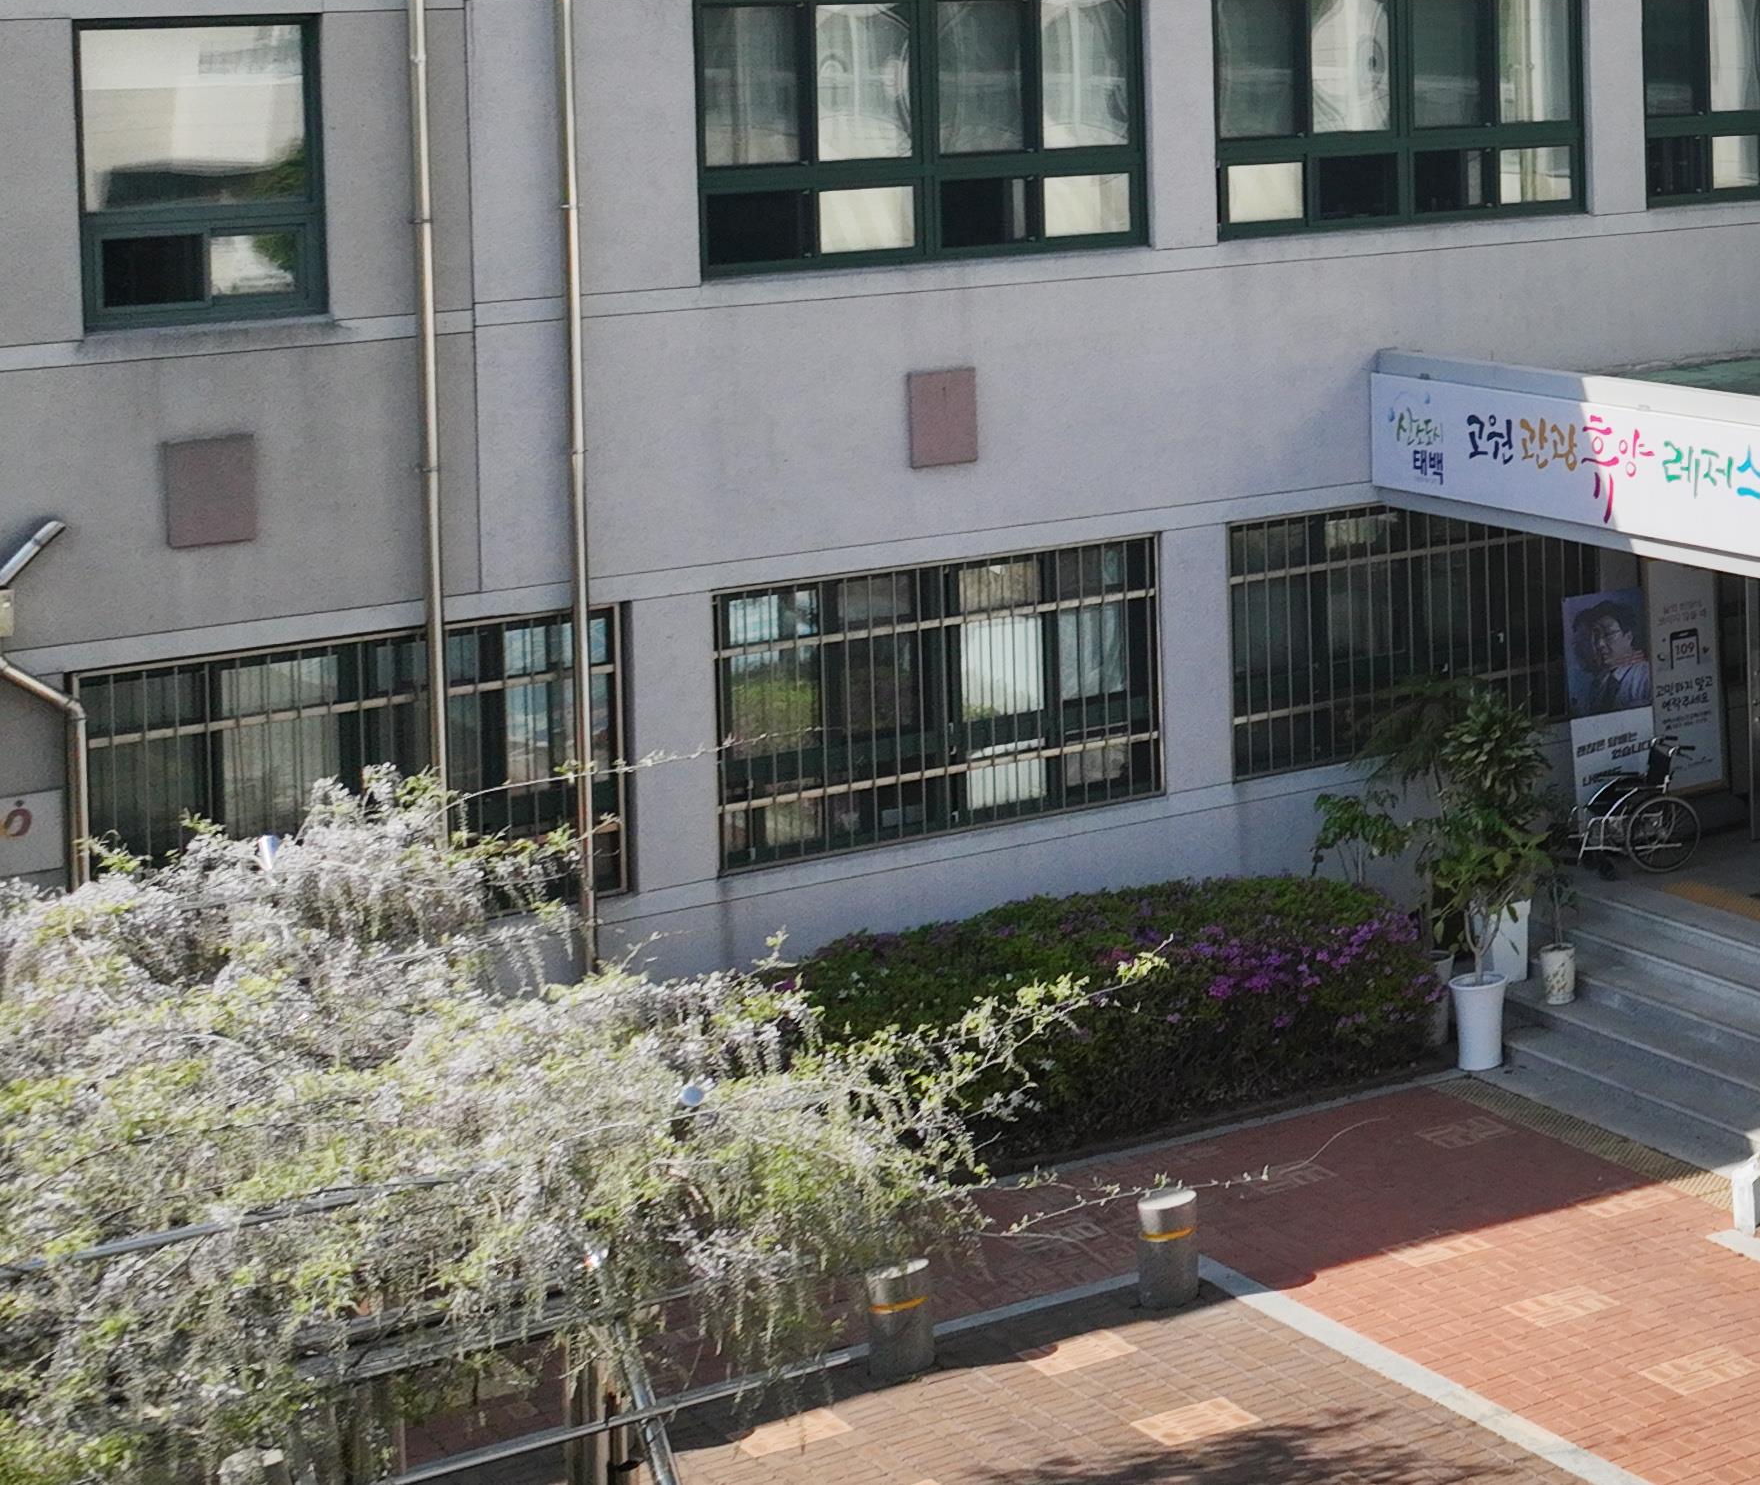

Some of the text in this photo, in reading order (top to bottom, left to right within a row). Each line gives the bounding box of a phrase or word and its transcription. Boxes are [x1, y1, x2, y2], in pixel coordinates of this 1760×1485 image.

[1413, 450, 1444, 485] 태백
[1467, 414, 1514, 464] 고원
[1519, 418, 1578, 471] 관광
[1582, 415, 1655, 524] 휴양
[1675, 642, 1695, 655] 109
